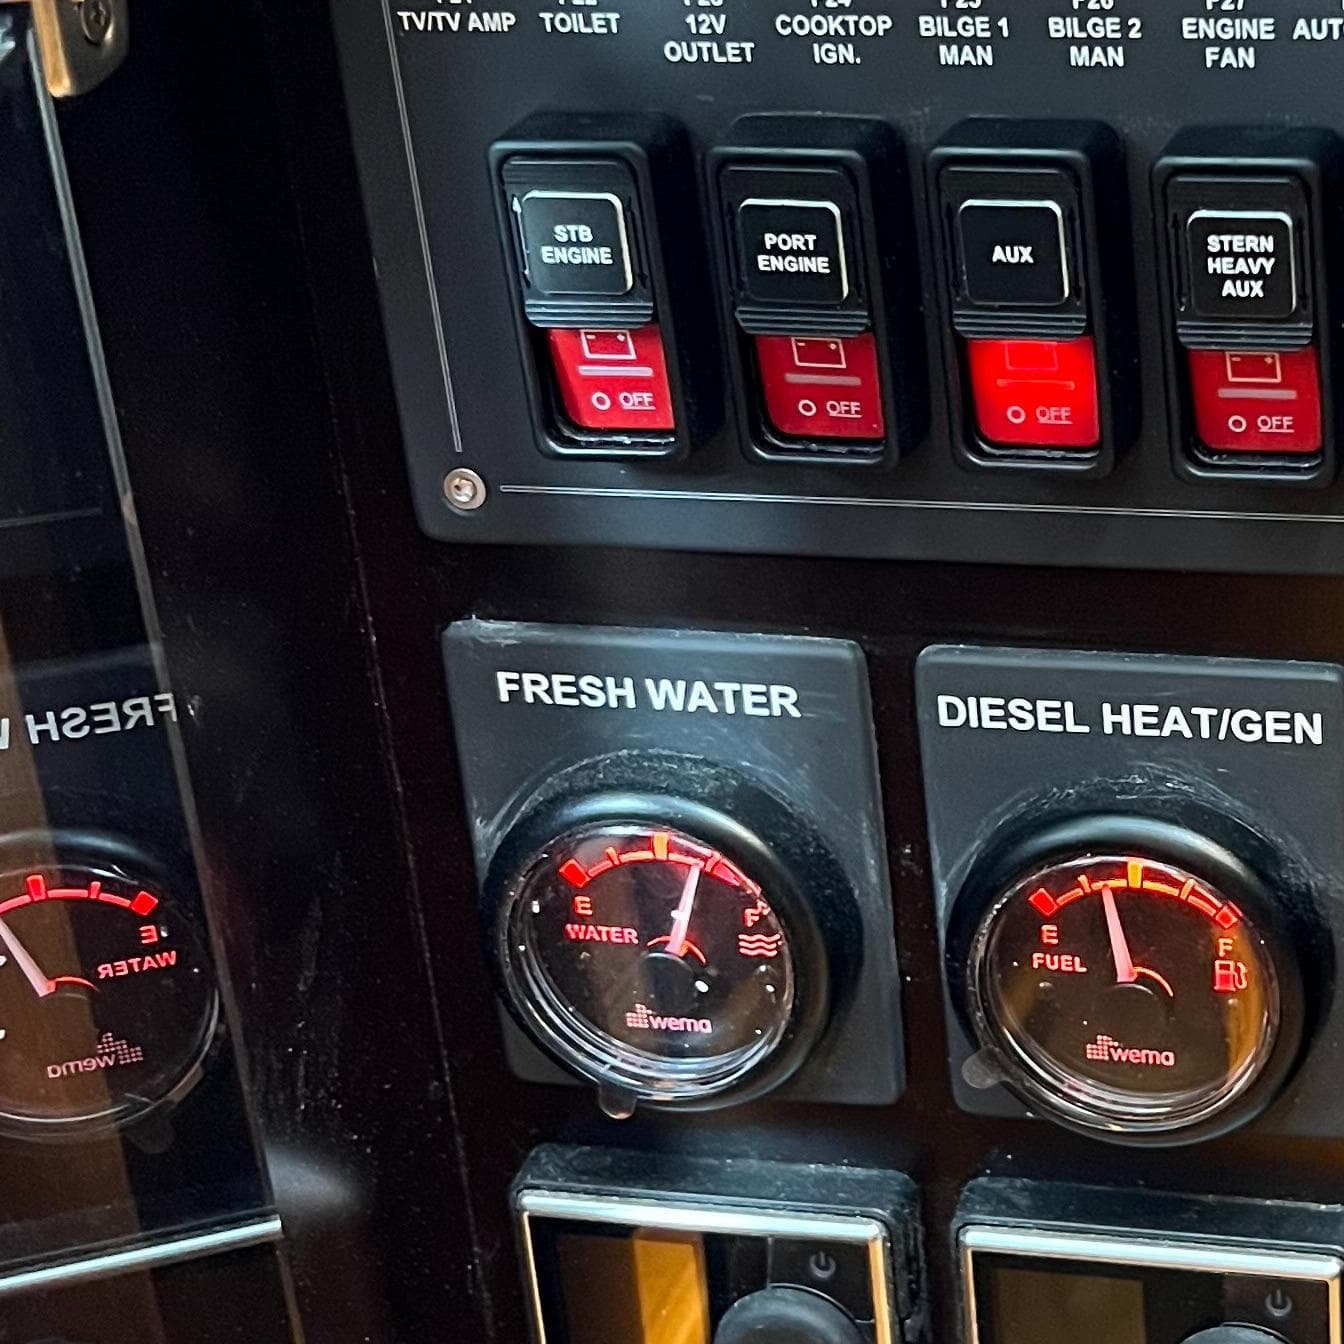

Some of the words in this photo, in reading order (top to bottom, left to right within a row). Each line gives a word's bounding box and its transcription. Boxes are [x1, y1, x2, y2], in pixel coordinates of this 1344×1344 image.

[396, 11, 461, 32] TV/TV
[467, 11, 516, 32] AMP
[538, 11, 621, 34] TOILET
[684, 13, 727, 35] 12V
[775, 13, 893, 36] COOKTOP
[918, 15, 992, 38] BILGE
[997, 16, 1009, 38] 1
[1048, 16, 1122, 39] BILGE
[1127, 17, 1142, 39] 2
[1181, 17, 1276, 40] ENGINE
[663, 40, 755, 63] OUTLET
[812, 42, 861, 64] IGN.
[938, 44, 993, 66] MAN
[1069, 45, 1125, 67] MAN
[1205, 46, 1255, 69] FAN
[553, 224, 594, 243] STB
[764, 232, 817, 251] PORT
[1207, 234, 1274, 253] STERN
[539, 245, 613, 265] ENGINE
[757, 254, 831, 274] ENGINE
[992, 245, 1034, 264] AUX
[1207, 256, 1276, 275] HEAVY
[1221, 279, 1264, 298] AUX
[619, 391, 655, 410] OFF
[825, 399, 863, 418] OFF
[1035, 406, 1073, 425] OFF
[1257, 416, 1294, 433] OFF
[496, 671, 637, 709] FRESH
[644, 678, 802, 718] WATER
[937, 694, 1090, 733] DIESEL
[1102, 702, 1323, 745] HEAT/GEN
[572, 895, 594, 916] E
[745, 906, 763, 927] F
[565, 923, 639, 945] WATER
[1041, 924, 1059, 945] E
[1218, 939, 1232, 956] F
[1032, 952, 1088, 973] FUEL
